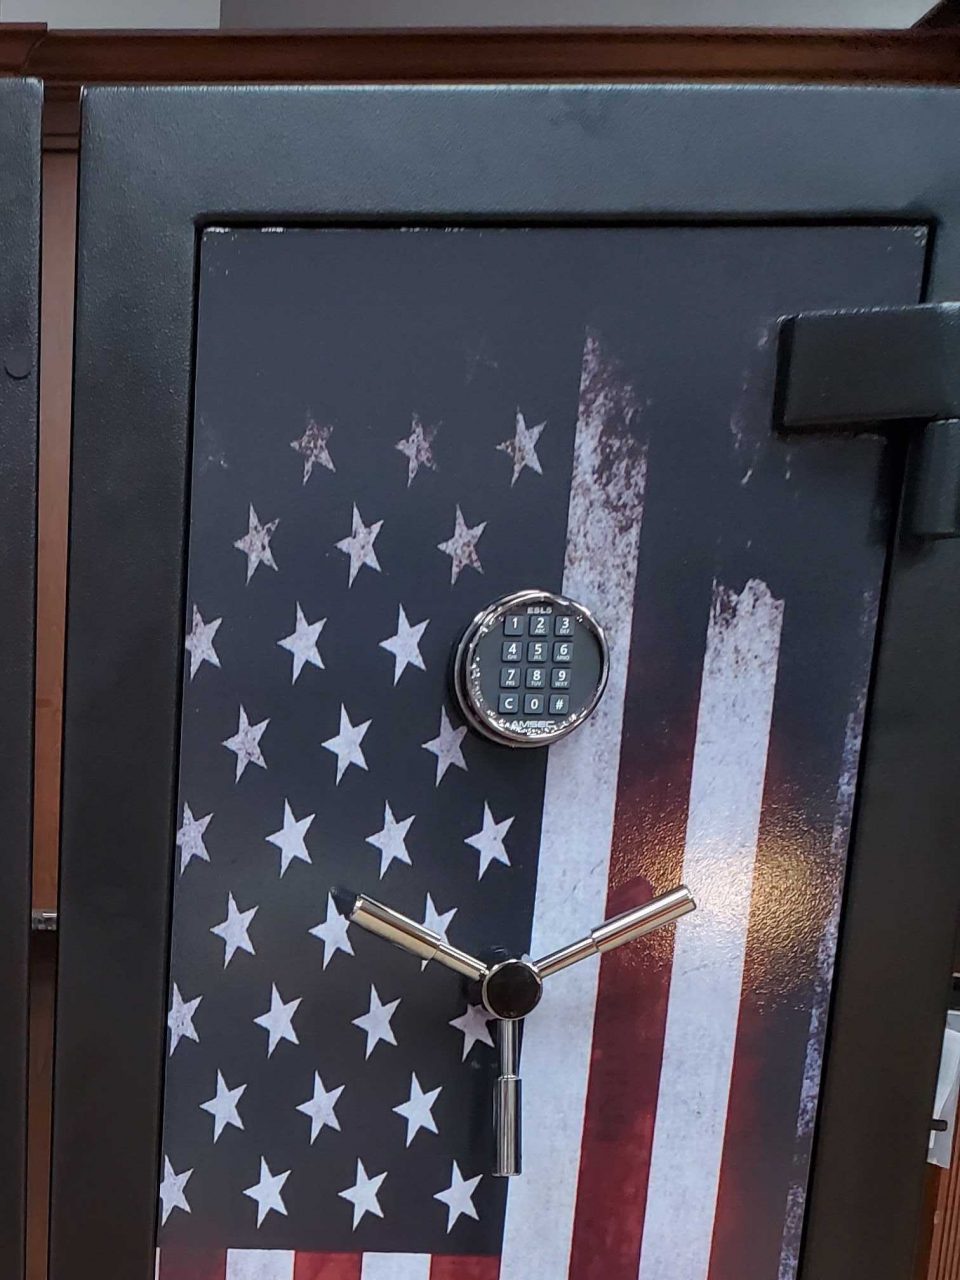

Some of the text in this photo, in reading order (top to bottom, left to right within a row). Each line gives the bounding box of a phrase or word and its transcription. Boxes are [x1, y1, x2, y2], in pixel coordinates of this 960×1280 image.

[512, 618, 569, 628] 1 2 3
[508, 644, 568, 655] 4 5 6
[508, 670, 566, 681] 7 8 9
[505, 698, 564, 710] C 0 #
